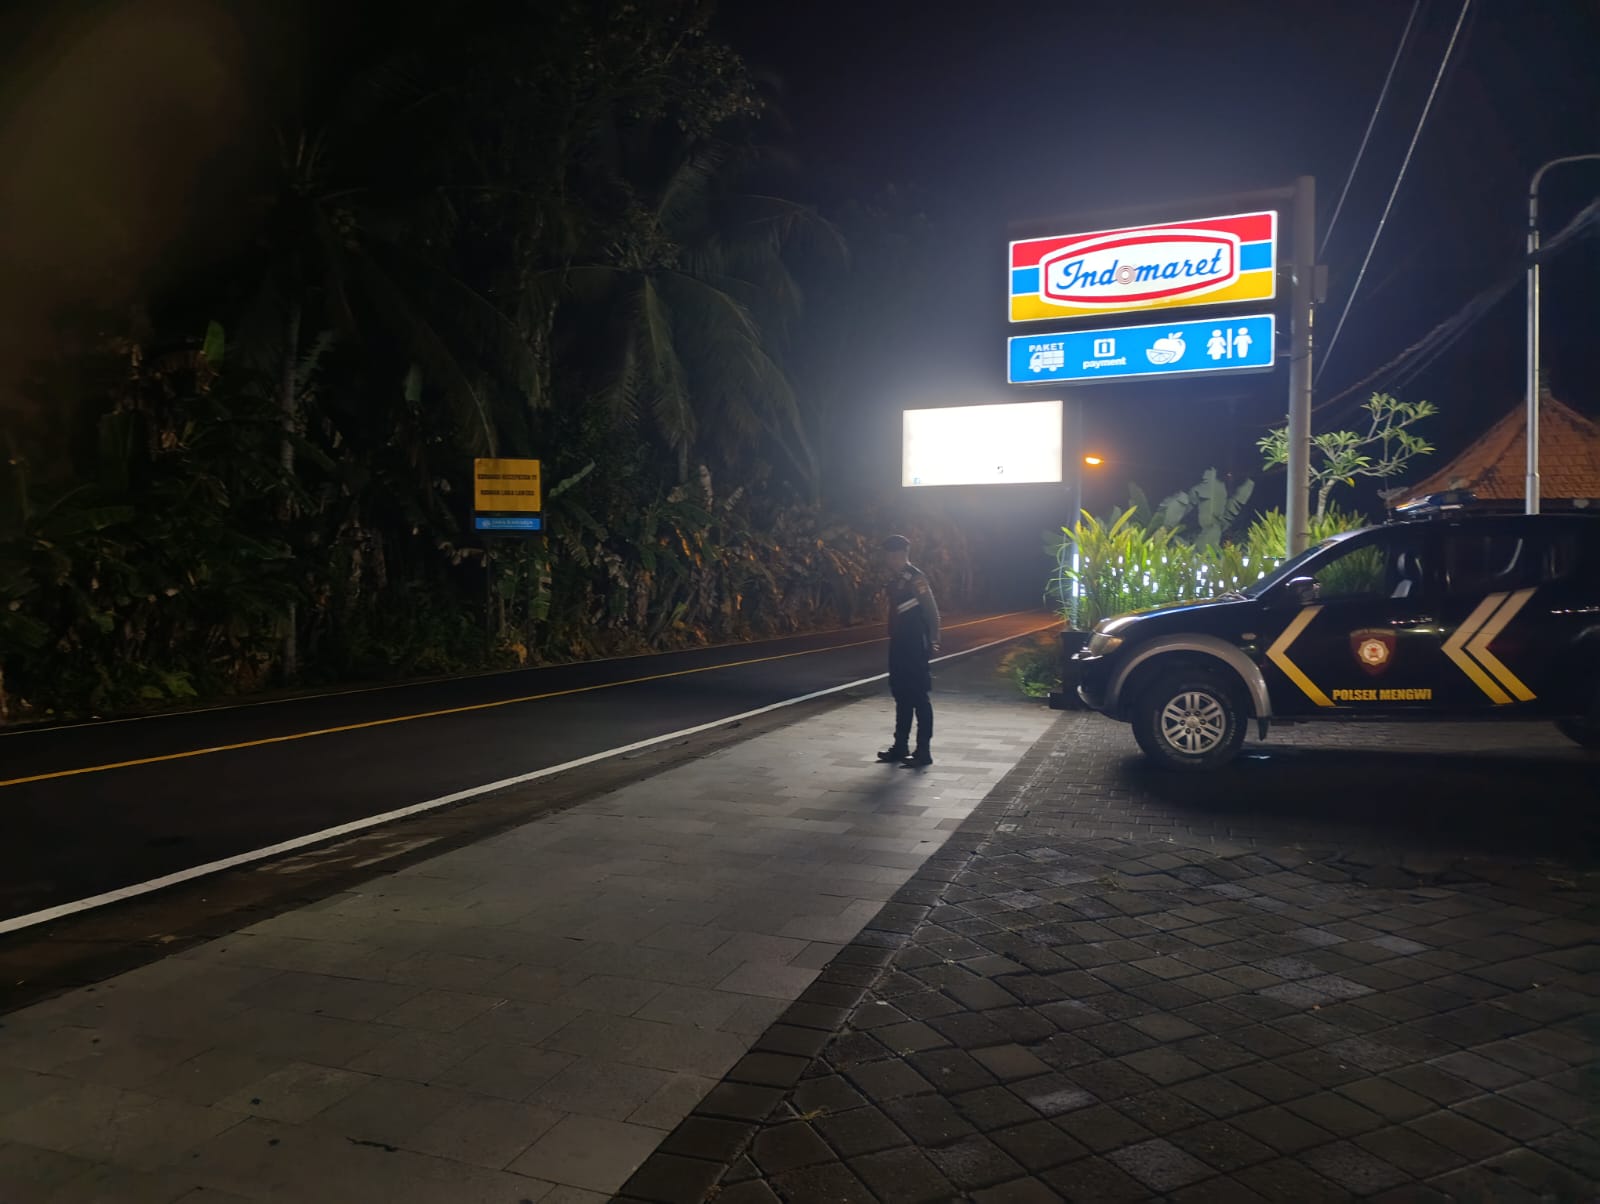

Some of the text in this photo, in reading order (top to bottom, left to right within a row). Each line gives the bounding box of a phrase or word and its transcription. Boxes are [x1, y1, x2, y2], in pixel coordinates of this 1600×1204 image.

[1056, 248, 1222, 290] Indomaret
[1029, 342, 1064, 352] PAKET
[1082, 357, 1127, 369] payment
[1332, 688, 1432, 701] POLSEK MENGWI
